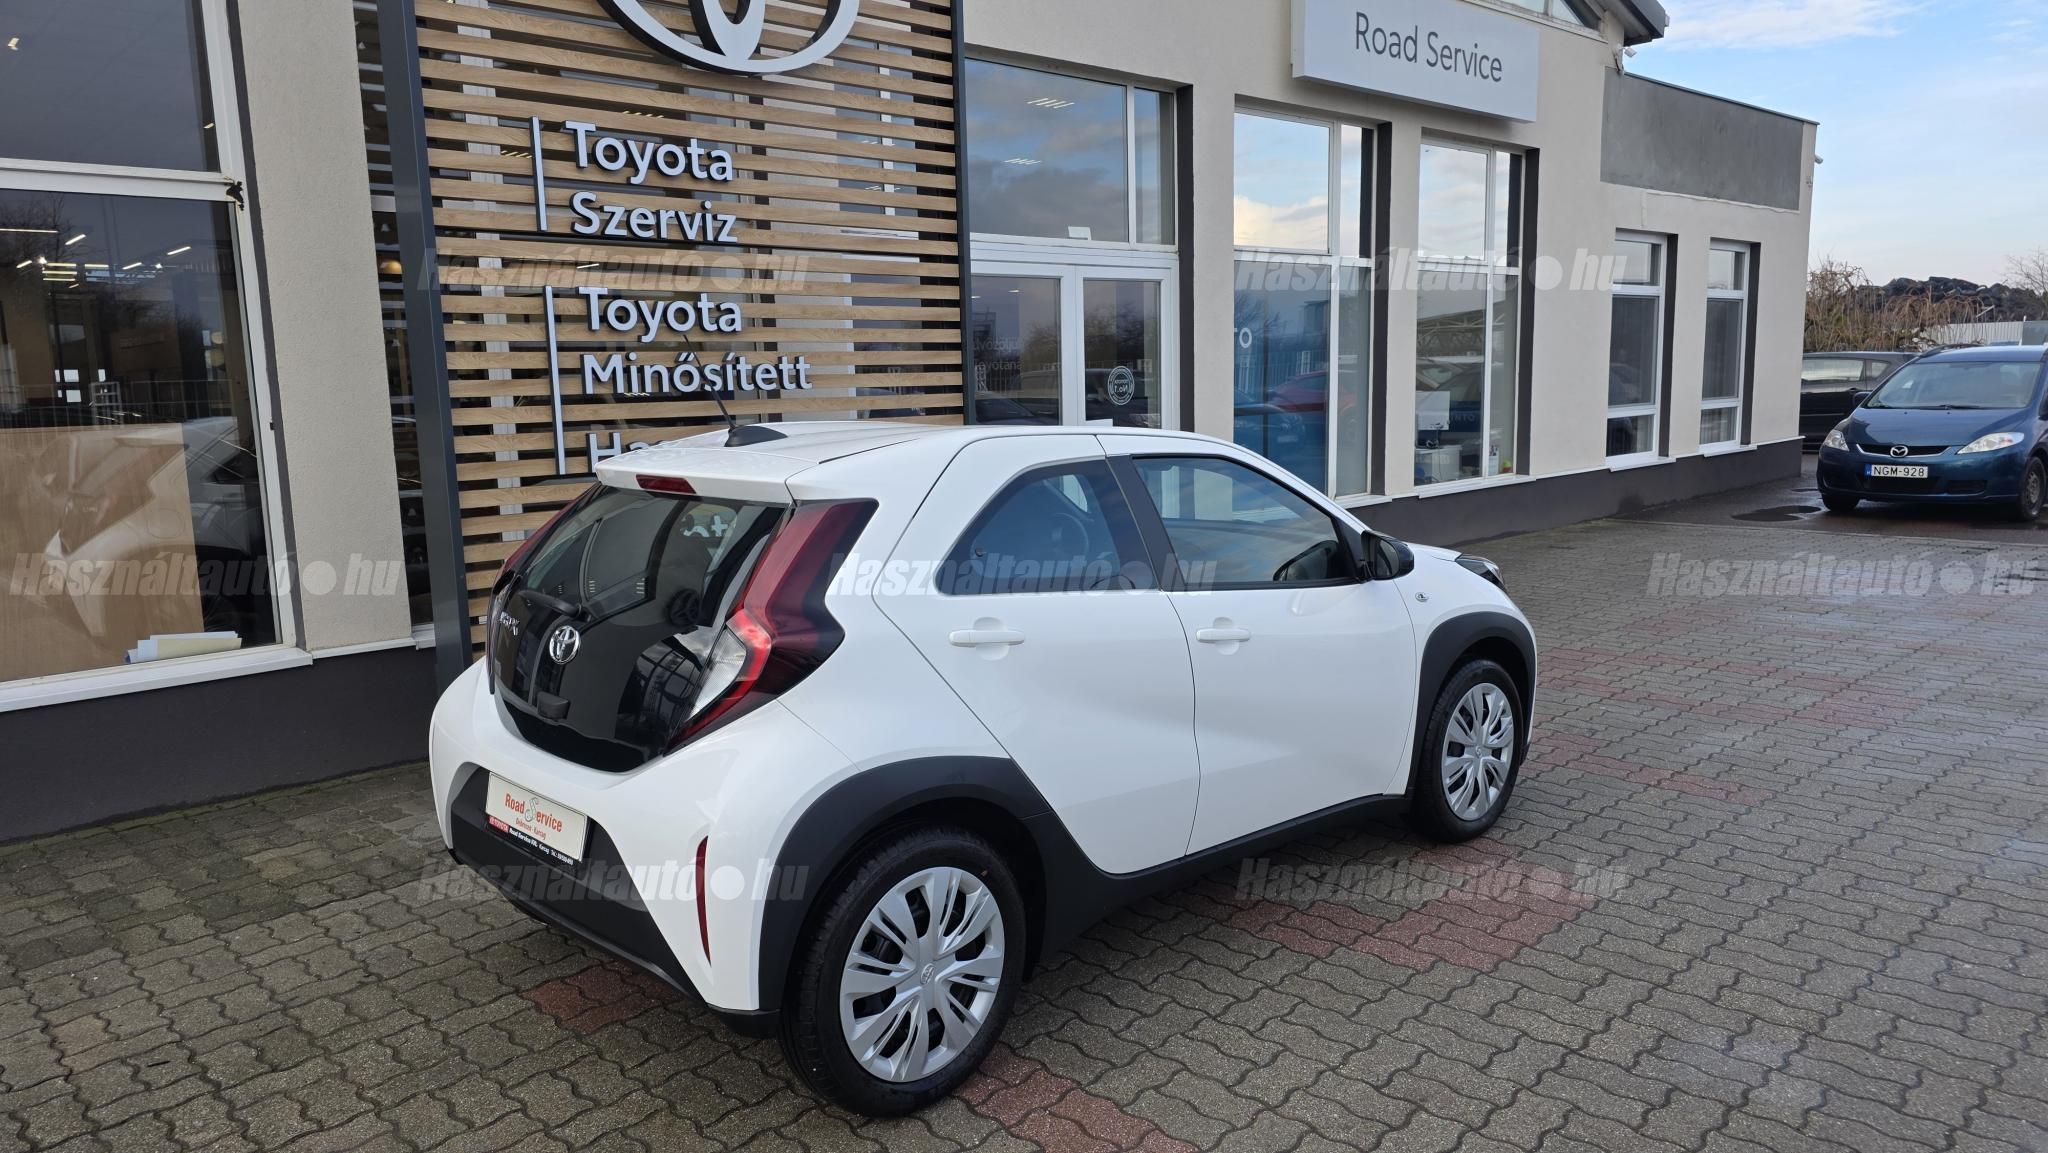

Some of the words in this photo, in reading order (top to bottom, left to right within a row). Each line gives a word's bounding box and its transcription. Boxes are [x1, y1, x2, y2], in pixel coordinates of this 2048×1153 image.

[1355, 11, 1418, 63] Road
[1426, 31, 1503, 82] Service
[563, 120, 734, 185] Toyota
[570, 191, 738, 243] Szerviz
[577, 286, 743, 343] Toyota
[582, 351, 814, 395] Minősített
[1873, 466, 1925, 477] NGM-928
[504, 793, 526, 815] Road
